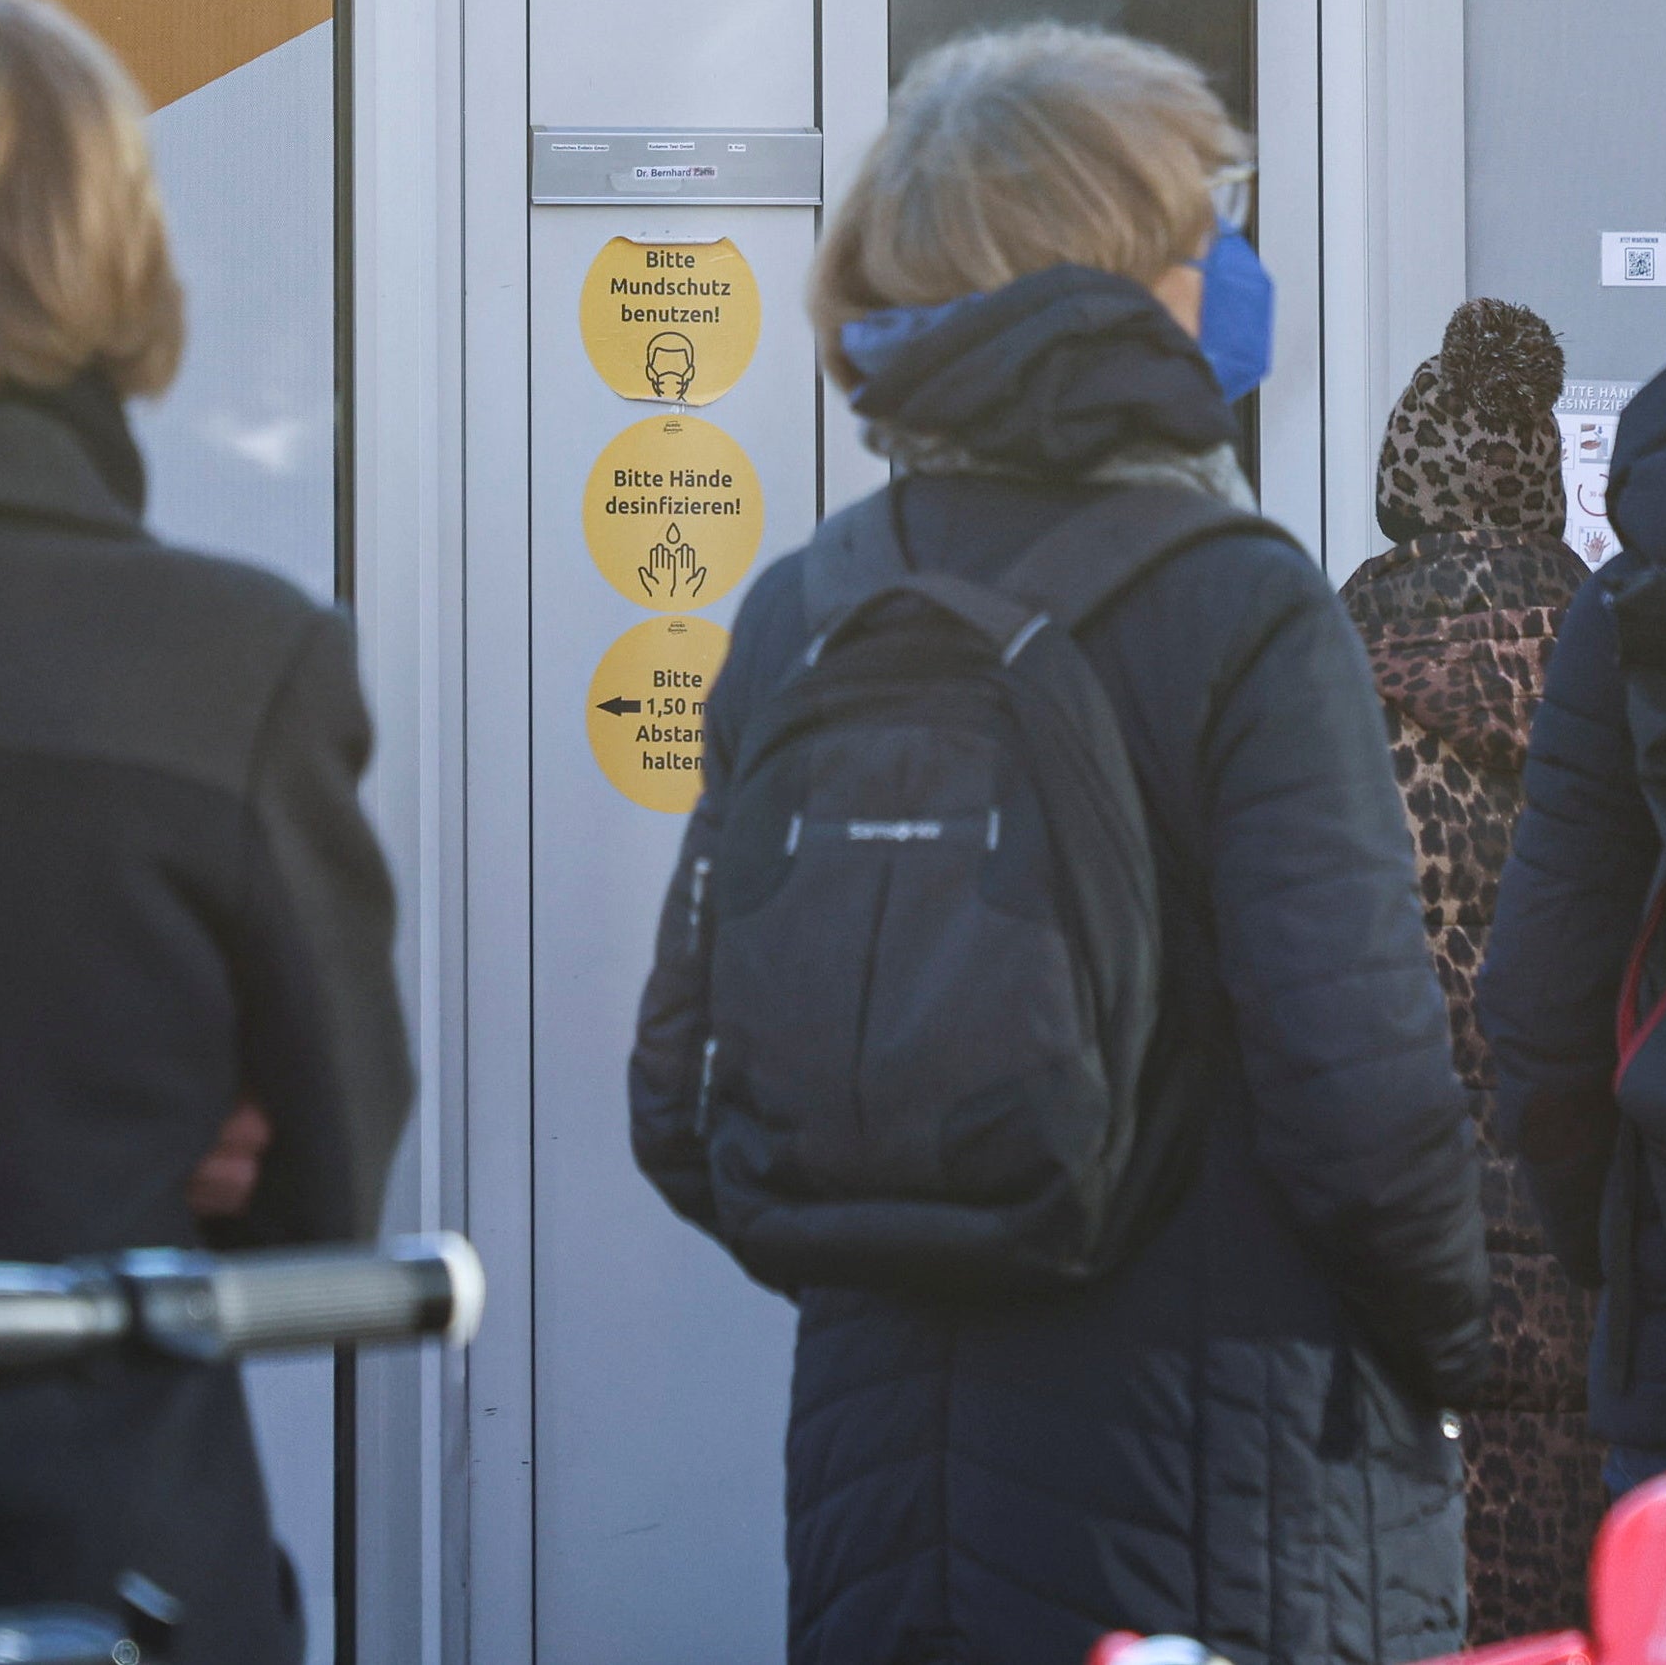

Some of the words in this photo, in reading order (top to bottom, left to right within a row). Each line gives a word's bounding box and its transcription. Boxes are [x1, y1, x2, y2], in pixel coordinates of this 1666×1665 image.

[636, 168, 649, 178] Dr.
[651, 167, 691, 178] Bernhard
[646, 250, 695, 268] Bitte
[610, 277, 731, 296] Mundschutz
[621, 304, 720, 323] benutzen!
[1564, 385, 1594, 397] ITTE
[614, 469, 663, 487] Bitte
[670, 469, 733, 487] Hände
[605, 496, 741, 515] desinfizieren!
[653, 669, 703, 688] Bitte
[646, 698, 686, 718] 1,50
[635, 724, 704, 743] Abstan
